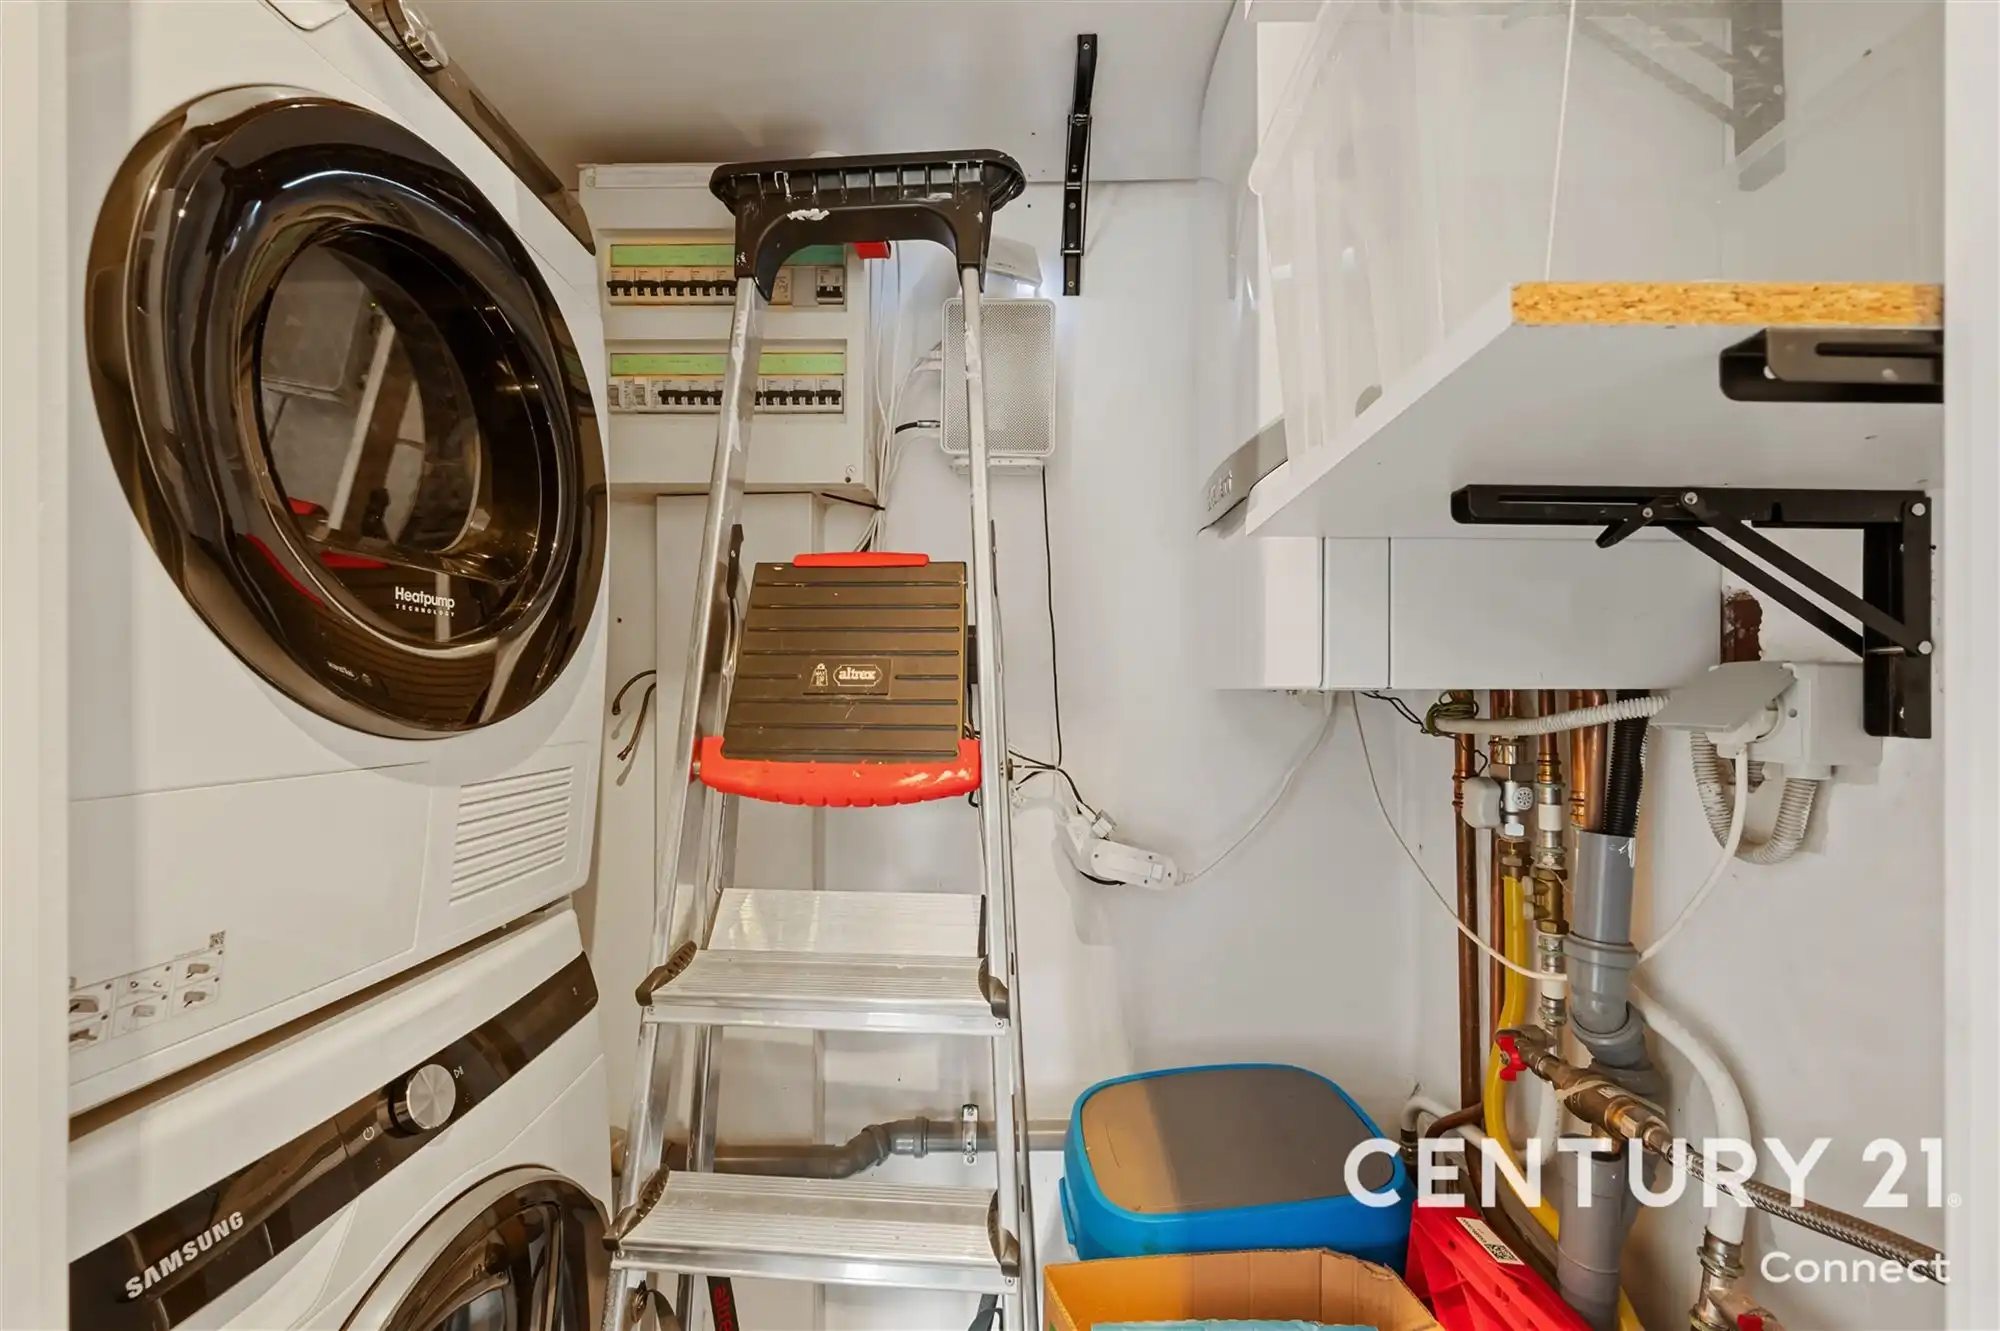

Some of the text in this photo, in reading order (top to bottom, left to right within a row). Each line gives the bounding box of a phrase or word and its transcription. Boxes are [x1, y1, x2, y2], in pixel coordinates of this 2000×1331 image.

[395, 586, 455, 610] Heatpump
[396, 603, 454, 617] TECHNOLOGY
[838, 667, 876, 680] altrex
[125, 1211, 244, 1299] SAMSUNG
